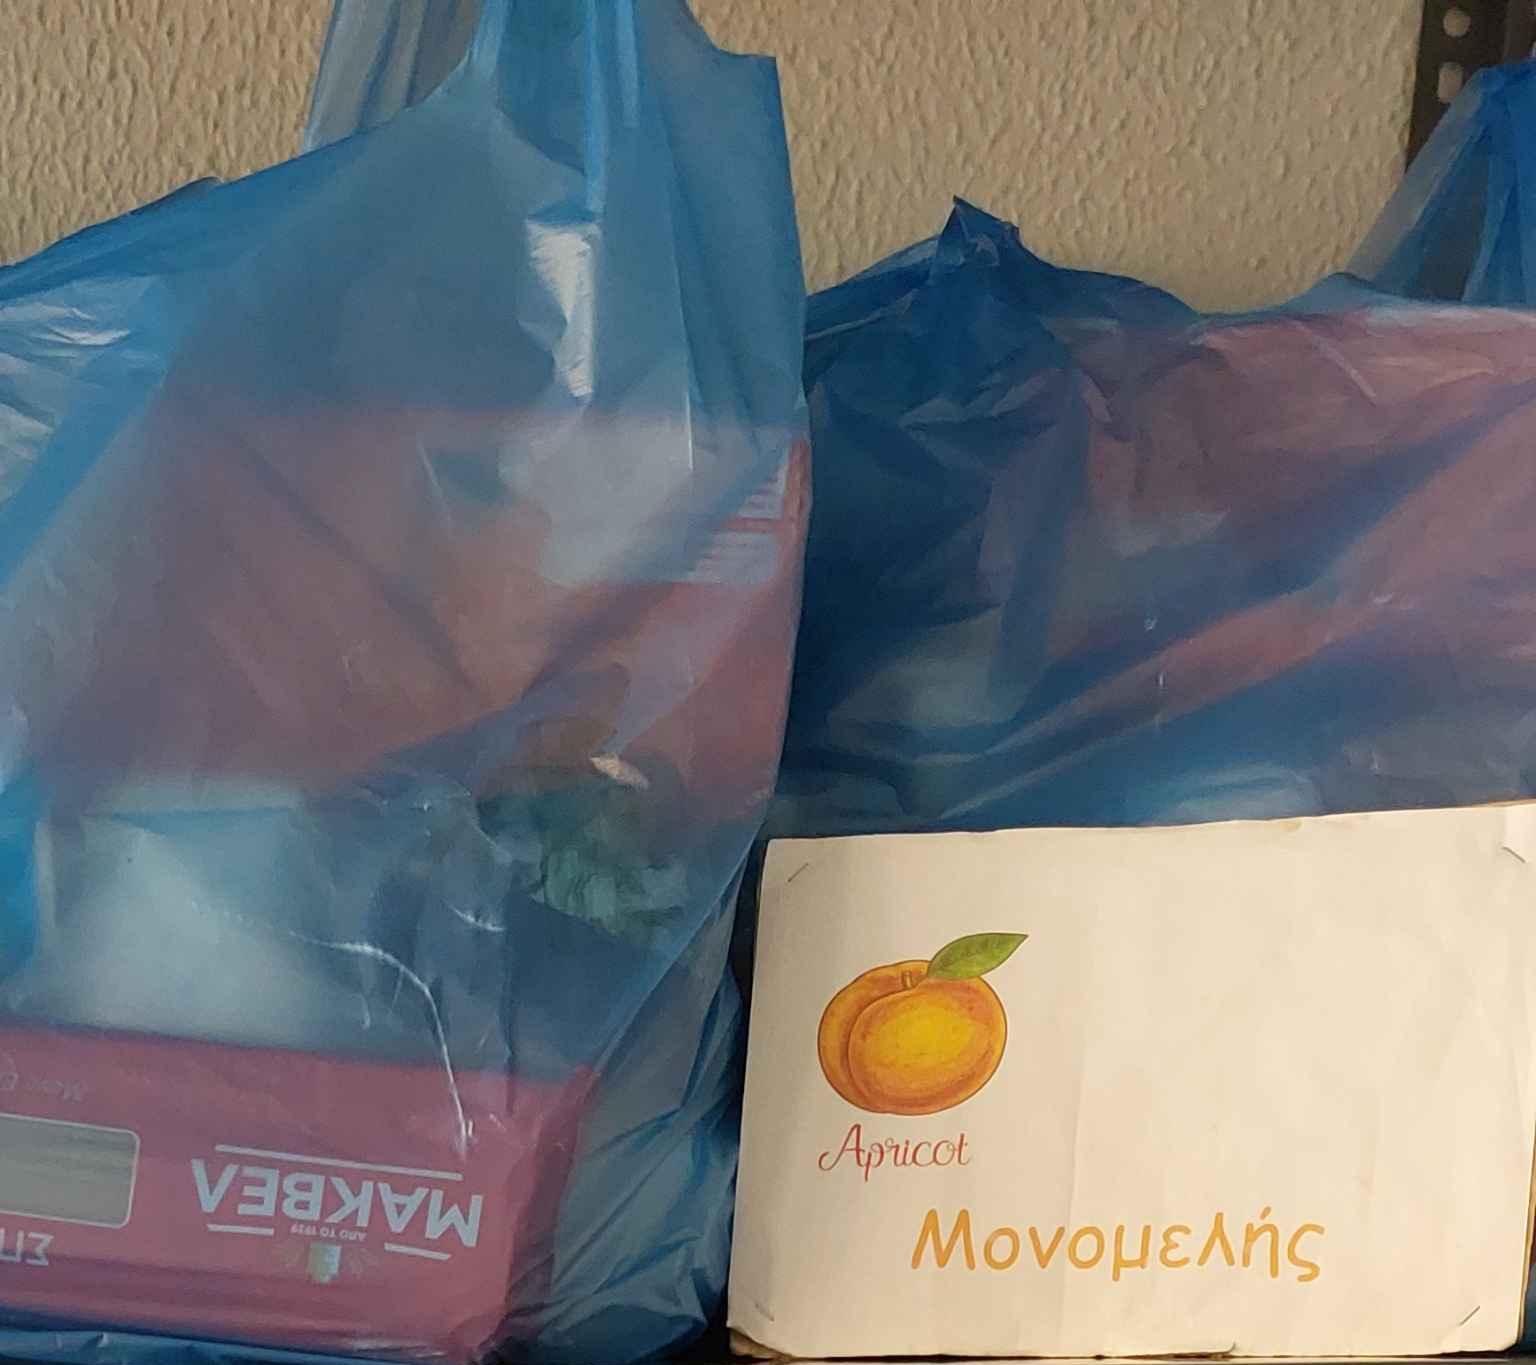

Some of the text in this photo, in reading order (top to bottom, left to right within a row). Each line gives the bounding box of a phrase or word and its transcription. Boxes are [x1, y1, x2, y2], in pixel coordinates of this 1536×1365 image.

[818, 1123, 972, 1181] Apricot
[191, 1158, 484, 1248] ΜΑΚΒΕΛ
[910, 1206, 1326, 1283] Μονομελής
